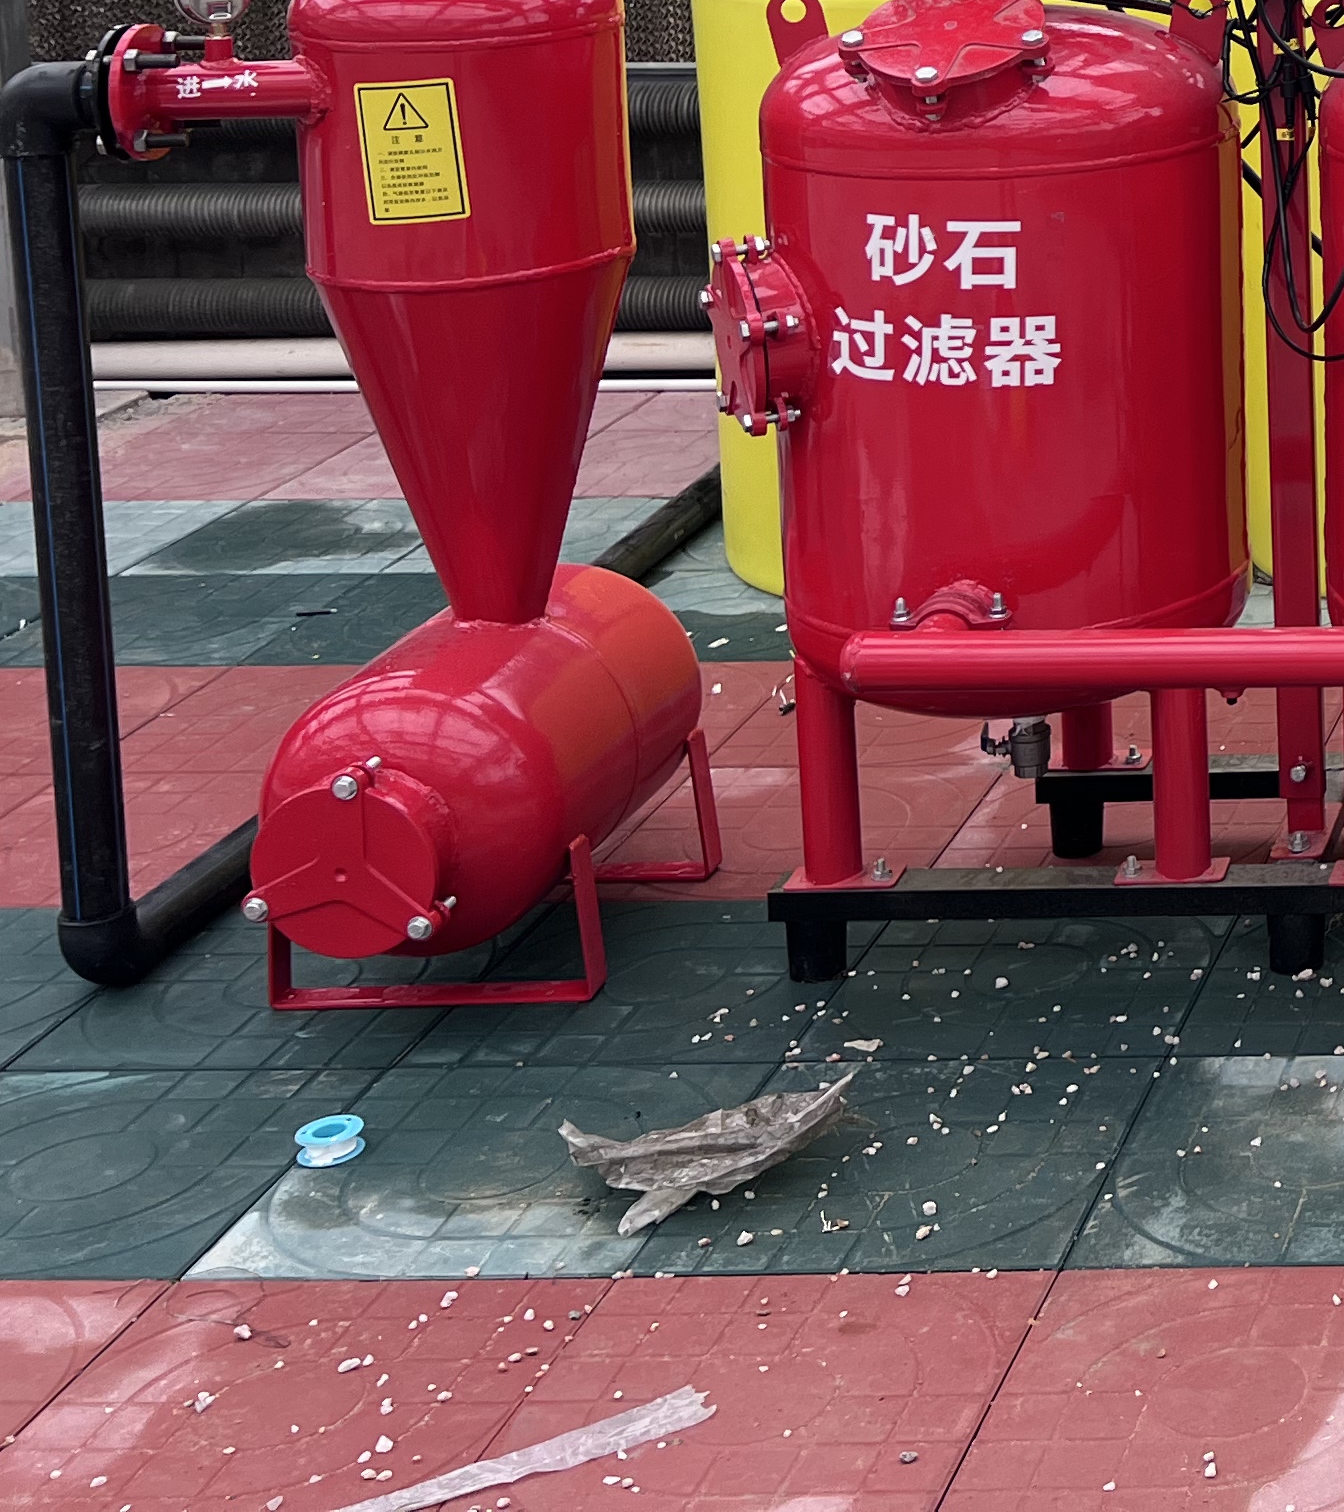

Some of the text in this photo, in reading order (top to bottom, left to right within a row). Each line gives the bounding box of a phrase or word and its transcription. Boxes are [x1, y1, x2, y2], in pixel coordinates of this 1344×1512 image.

[176, 69, 259, 99] 进 水
[391, 134, 423, 145] 注意
[864, 213, 1022, 290] 砂石
[831, 306, 1062, 388] 过滤器
